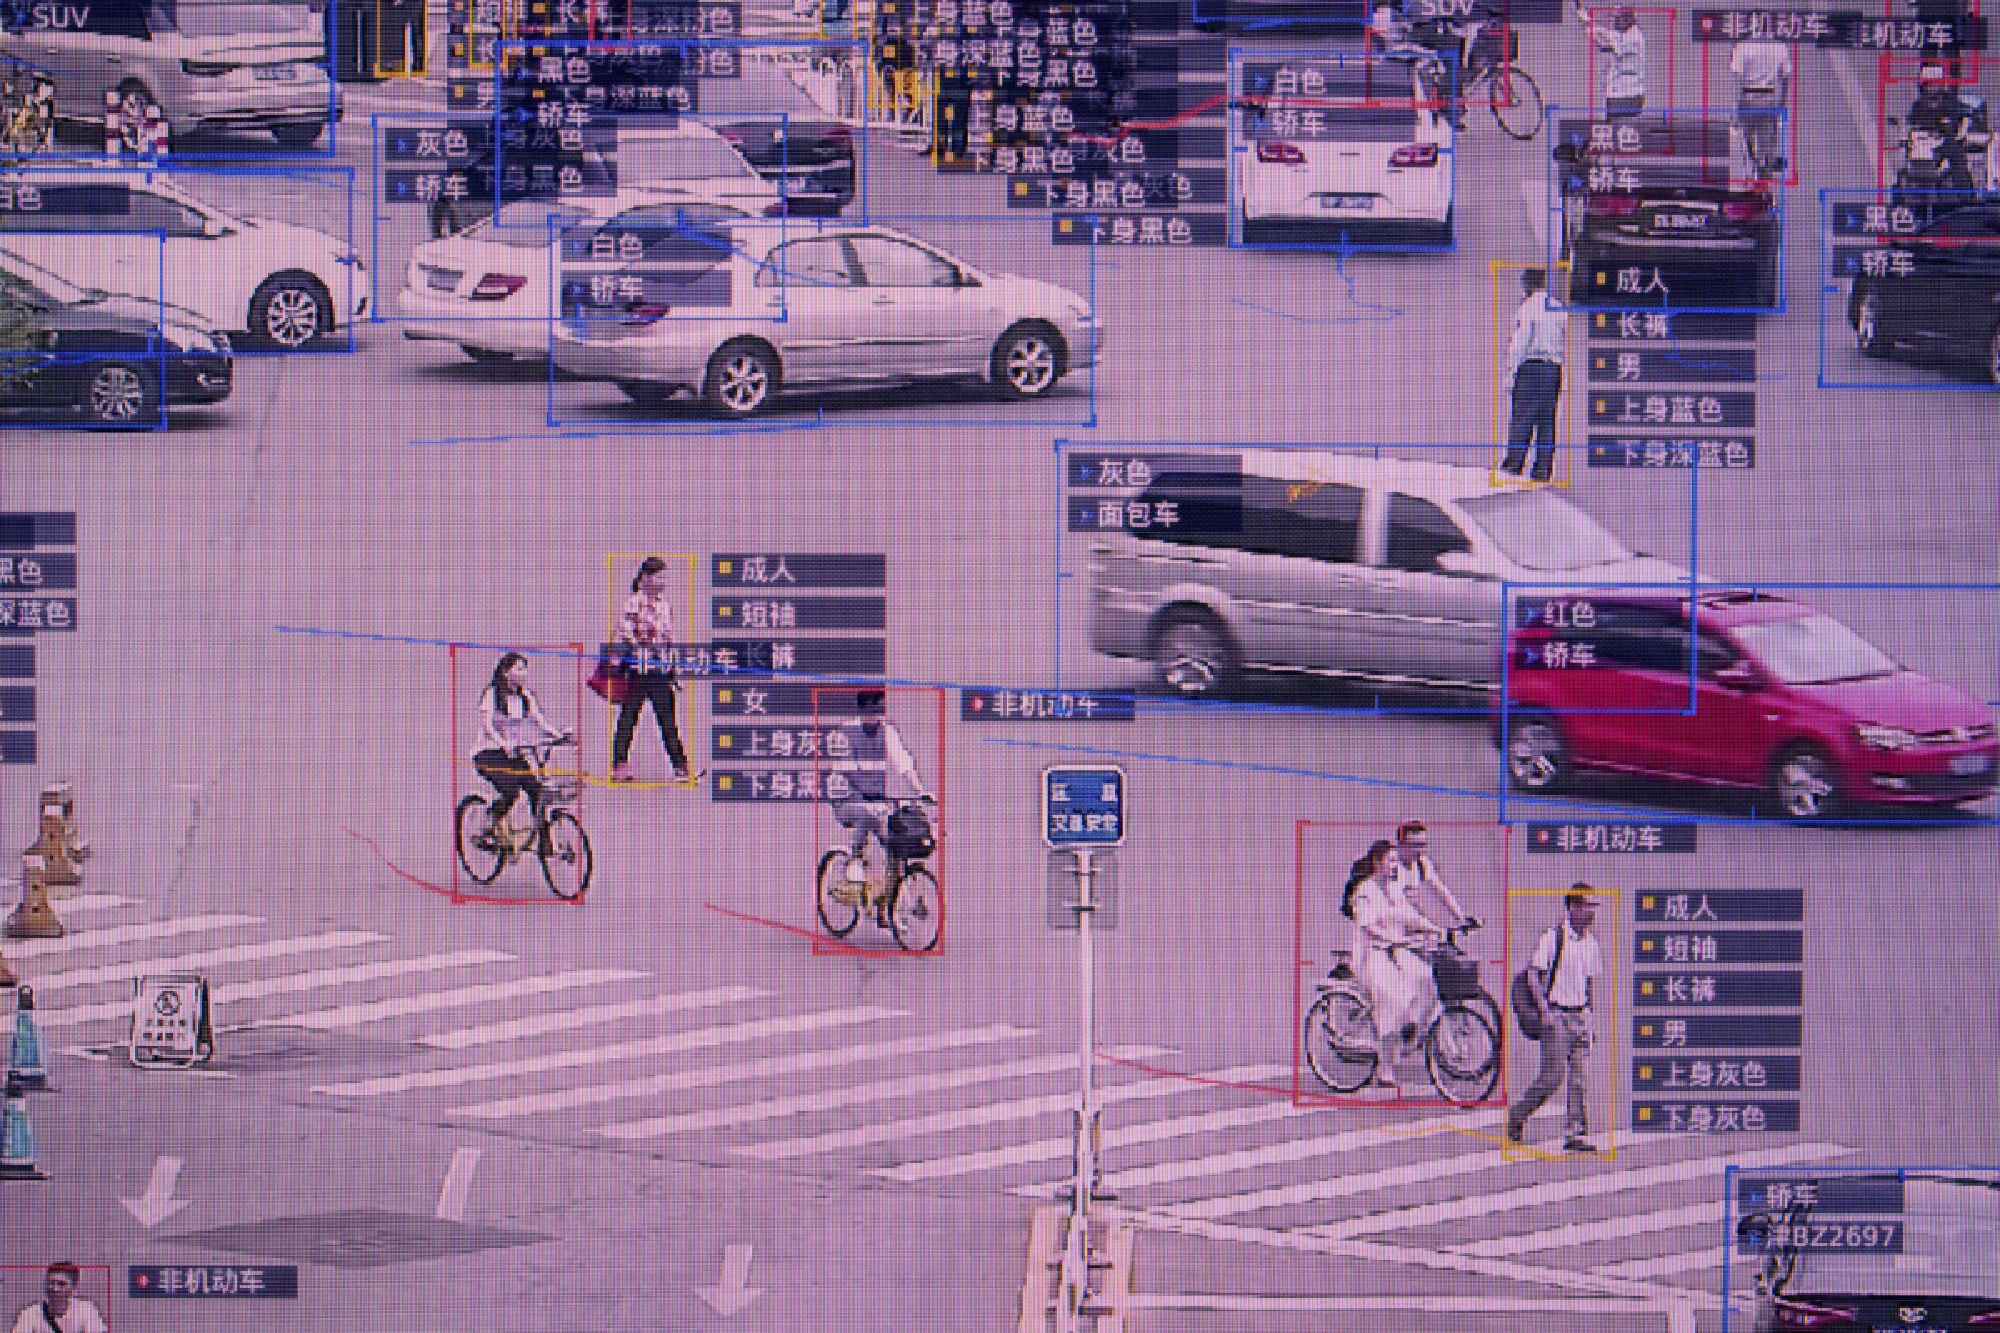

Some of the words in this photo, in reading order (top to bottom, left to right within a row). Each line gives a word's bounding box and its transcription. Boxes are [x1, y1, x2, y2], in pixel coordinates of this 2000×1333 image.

[32, 5, 91, 29] SUV
[1722, 12, 1829, 39] 非机动车
[539, 56, 591, 84] 黑色
[1275, 67, 1327, 94] 白色
[538, 101, 592, 128] 轿车
[1272, 111, 1328, 137] 轿车
[416, 130, 469, 158] 灰色
[1589, 124, 1642, 152] 黑色
[415, 173, 468, 201] 轿车
[1589, 166, 1641, 193] 轿车
[1040, 181, 1146, 208] 下身黑色
[1863, 206, 1916, 233] 黑色
[1863, 250, 1916, 278] 轿车
[591, 274, 643, 304] 轿车
[1616, 266, 1669, 294] 成人
[1617, 312, 1668, 339] 长裤
[1616, 353, 1641, 381] 男
[1616, 396, 1723, 423] 上身蓝色
[1098, 459, 1152, 485] 灰色
[1098, 501, 1181, 528] 面包车
[742, 556, 796, 584] 成人
[741, 601, 797, 628] 短袖
[1542, 601, 1597, 628] 红色
[1542, 643, 1597, 669] 轿车
[742, 687, 768, 714] 女
[742, 729, 850, 757] 上身灰色
[1556, 825, 1663, 852] 非机动车
[1664, 894, 1718, 921] 成人
[1663, 935, 1718, 962] 短袖
[1662, 976, 1716, 1002] 长裤
[1661, 1019, 1687, 1047] 男
[1661, 1060, 1767, 1087] 上身灰色
[1661, 1104, 1767, 1131] 下身灰色
[1766, 1181, 1819, 1209] 轿车
[157, 1268, 265, 1294] 非机动车
